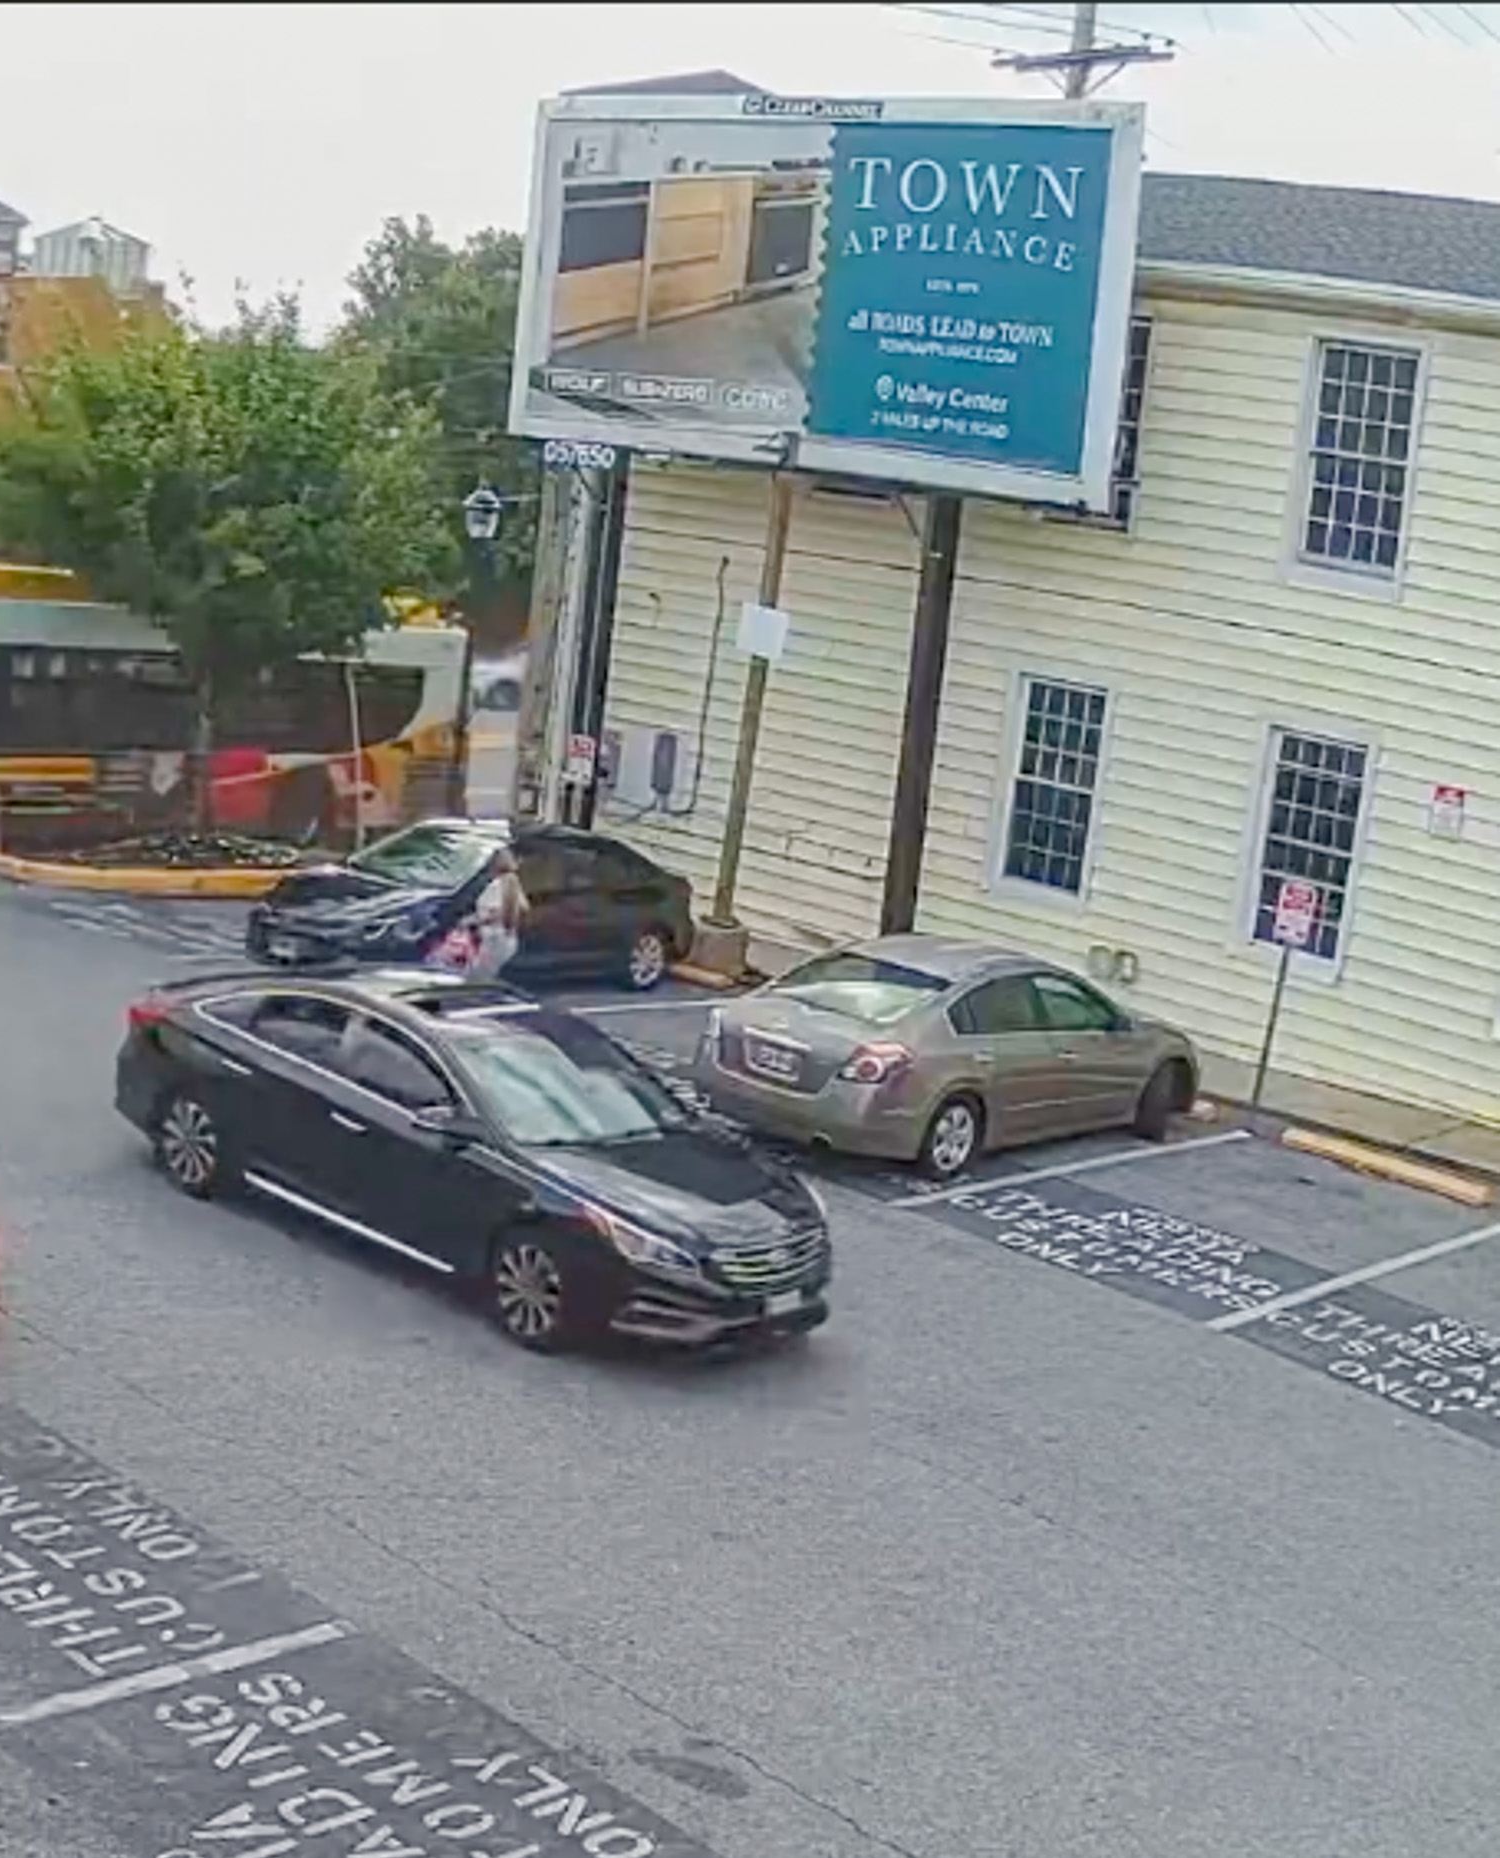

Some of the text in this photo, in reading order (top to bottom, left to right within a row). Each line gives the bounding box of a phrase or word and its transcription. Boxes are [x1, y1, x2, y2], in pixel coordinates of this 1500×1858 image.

[848, 156, 1086, 220] TOWN
[840, 222, 1077, 272] APPLIANCE
[999, 322, 1054, 348] TOWN
[896, 382, 1009, 413] Valley Center
[997, 1231, 1123, 1277] ONLY
[1327, 1359, 1463, 1414] ONLY
[48, 1478, 200, 1561] ONLY
[449, 1752, 658, 1858] ONLY
